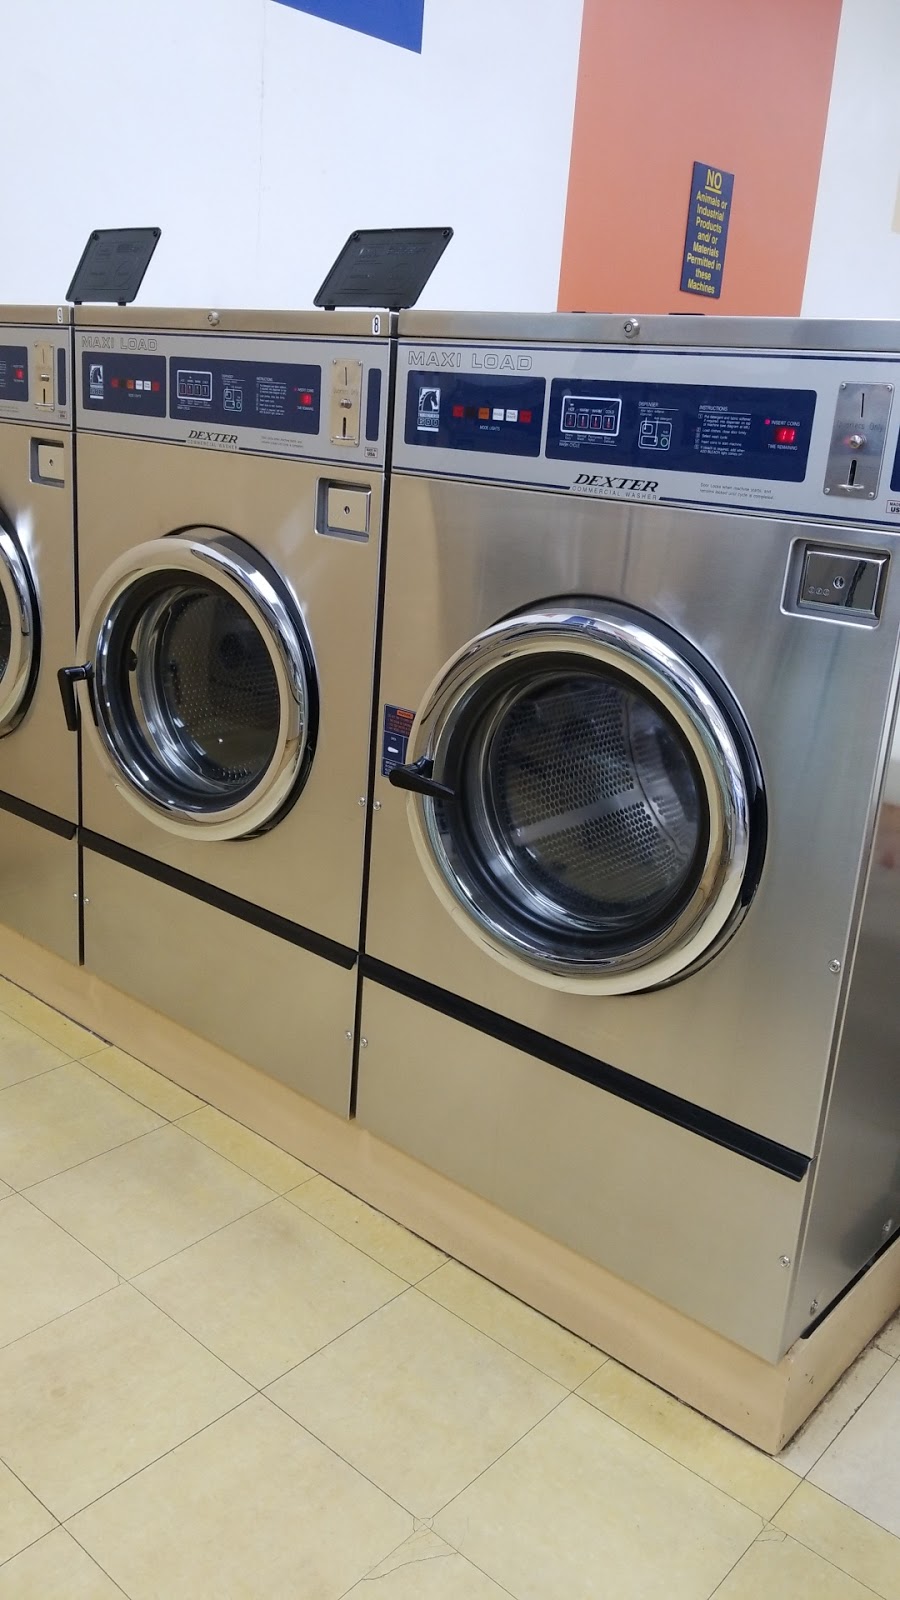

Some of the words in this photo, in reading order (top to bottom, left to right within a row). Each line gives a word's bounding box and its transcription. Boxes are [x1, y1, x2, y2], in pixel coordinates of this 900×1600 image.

[706, 168, 722, 189] NO
[696, 190, 721, 208] Animals
[720, 201, 728, 210] or
[697, 204, 725, 221] Industrial
[696, 216, 722, 233] Products
[697, 231, 711, 242] and/
[711, 235, 718, 245] or
[693, 242, 719, 258] Materials
[687, 252, 715, 270] Permitted
[715, 261, 722, 271] in
[695, 268, 712, 281] these
[687, 278, 715, 295] Machines
[374, 317, 379, 333] 8
[81, 335, 115, 349] MAXI
[120, 337, 158, 351] LOAD
[407, 350, 461, 368] MAXI
[471, 353, 533, 371] LOAD
[188, 430, 238, 443] DEXTER
[573, 473, 659, 492] DEXTER
[572, 486, 621, 497] COMMERCIAL
[625, 491, 657, 500] WASHER
